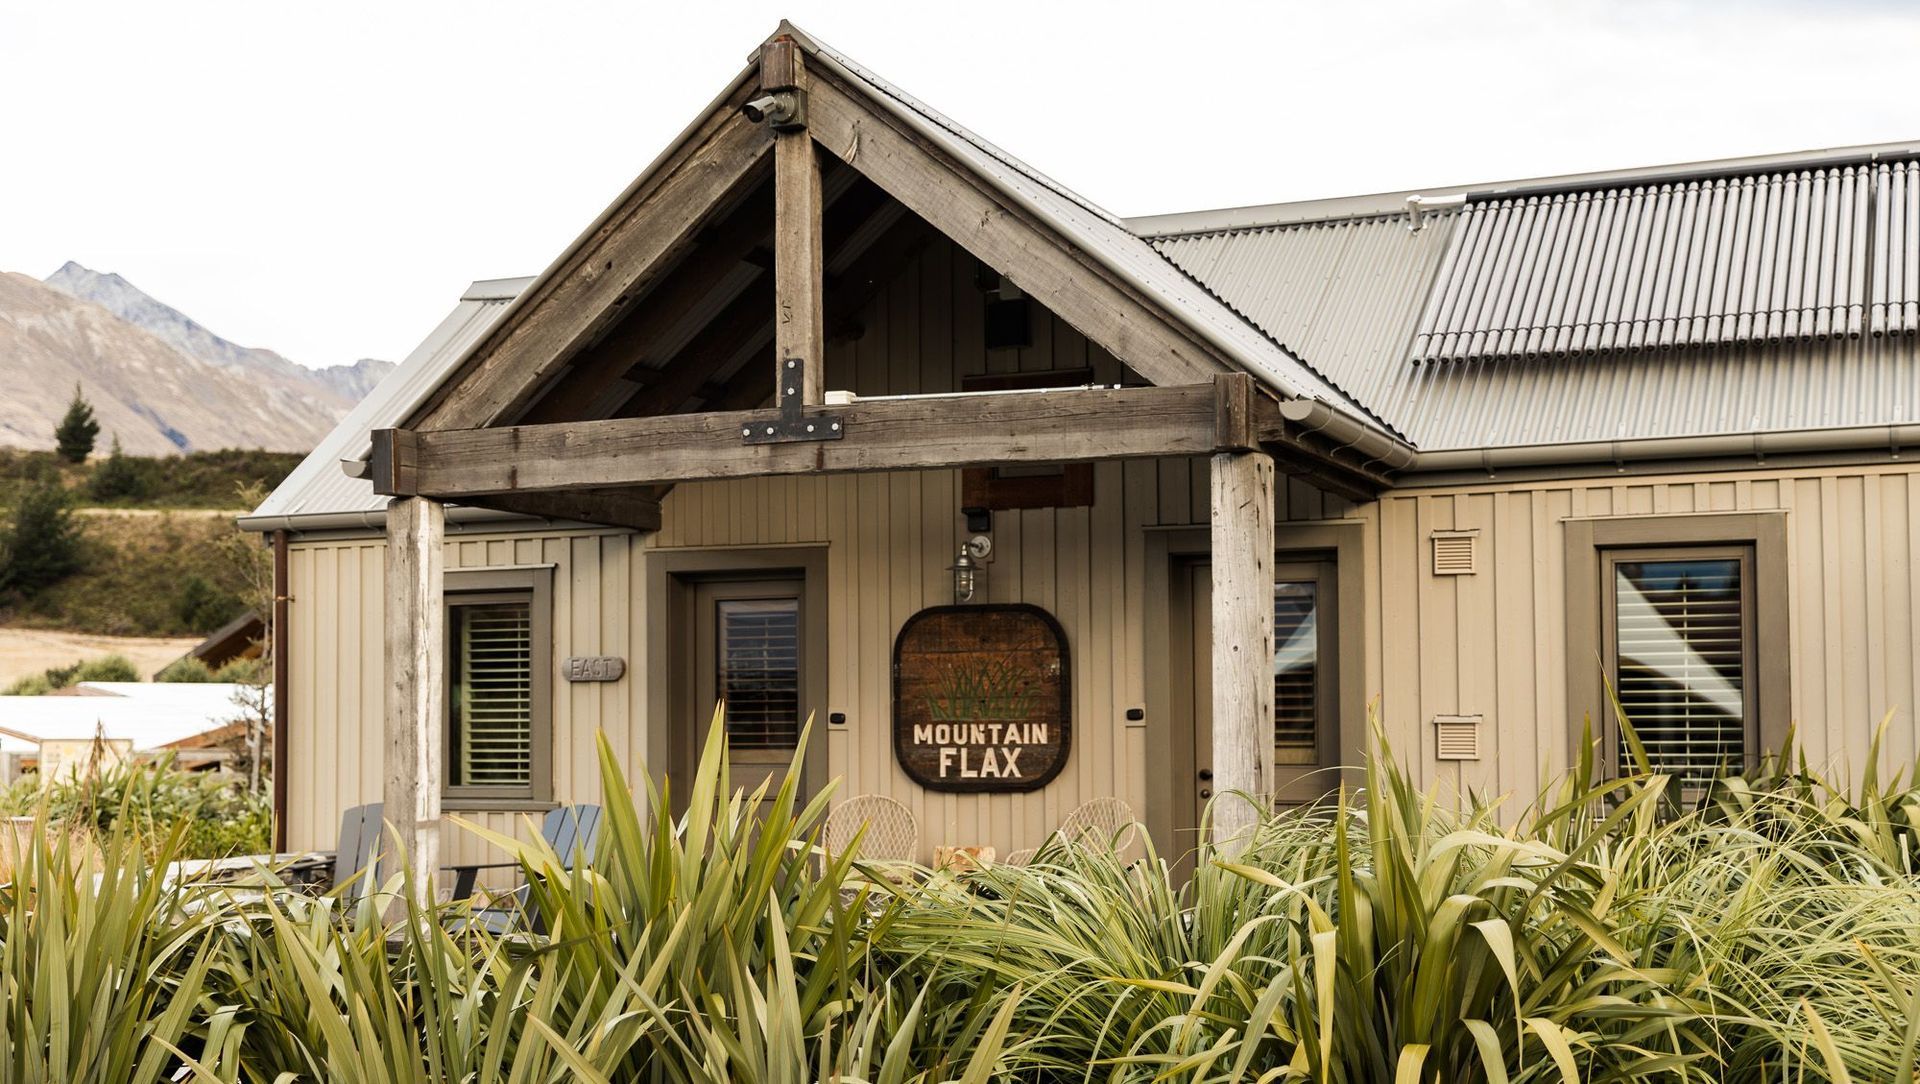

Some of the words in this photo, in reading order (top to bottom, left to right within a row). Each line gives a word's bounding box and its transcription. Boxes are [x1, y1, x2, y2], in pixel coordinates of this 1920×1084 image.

[570, 658, 612, 679] EAST
[913, 723, 1048, 745] MOUNTAIN
[939, 747, 1022, 778] FLAX
